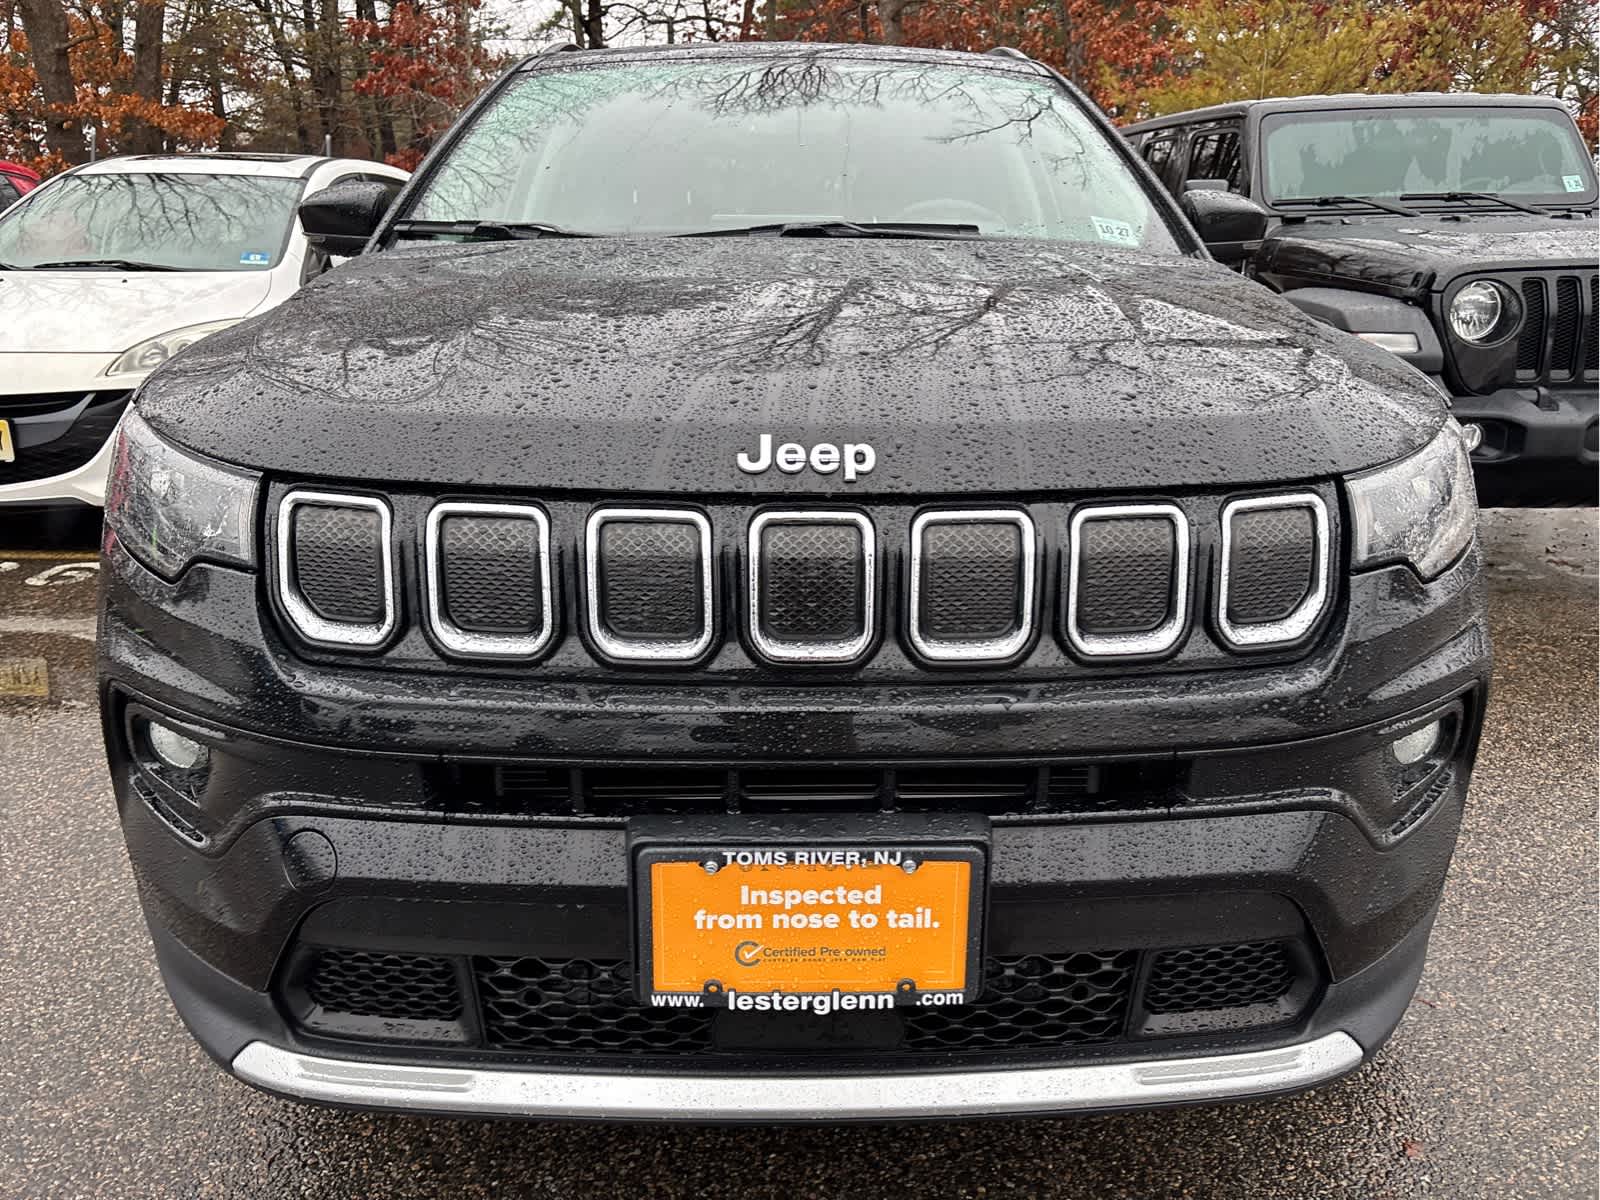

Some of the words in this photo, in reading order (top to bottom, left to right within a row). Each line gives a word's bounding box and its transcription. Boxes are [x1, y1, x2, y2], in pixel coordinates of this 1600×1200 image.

[736, 433, 876, 483] Jeep
[723, 850, 788, 866] TOMS
[794, 850, 868, 868] RIVER,
[873, 850, 901, 866] NJ
[740, 884, 882, 910] Inspected
[694, 908, 763, 930] from
[772, 913, 841, 929] nose
[847, 909, 878, 929] to
[886, 906, 940, 929] tail.
[763, 946, 817, 957] Certified
[651, 994, 705, 1008] www.
[728, 991, 895, 1015] lesterglenn
[915, 992, 964, 1007] .com
